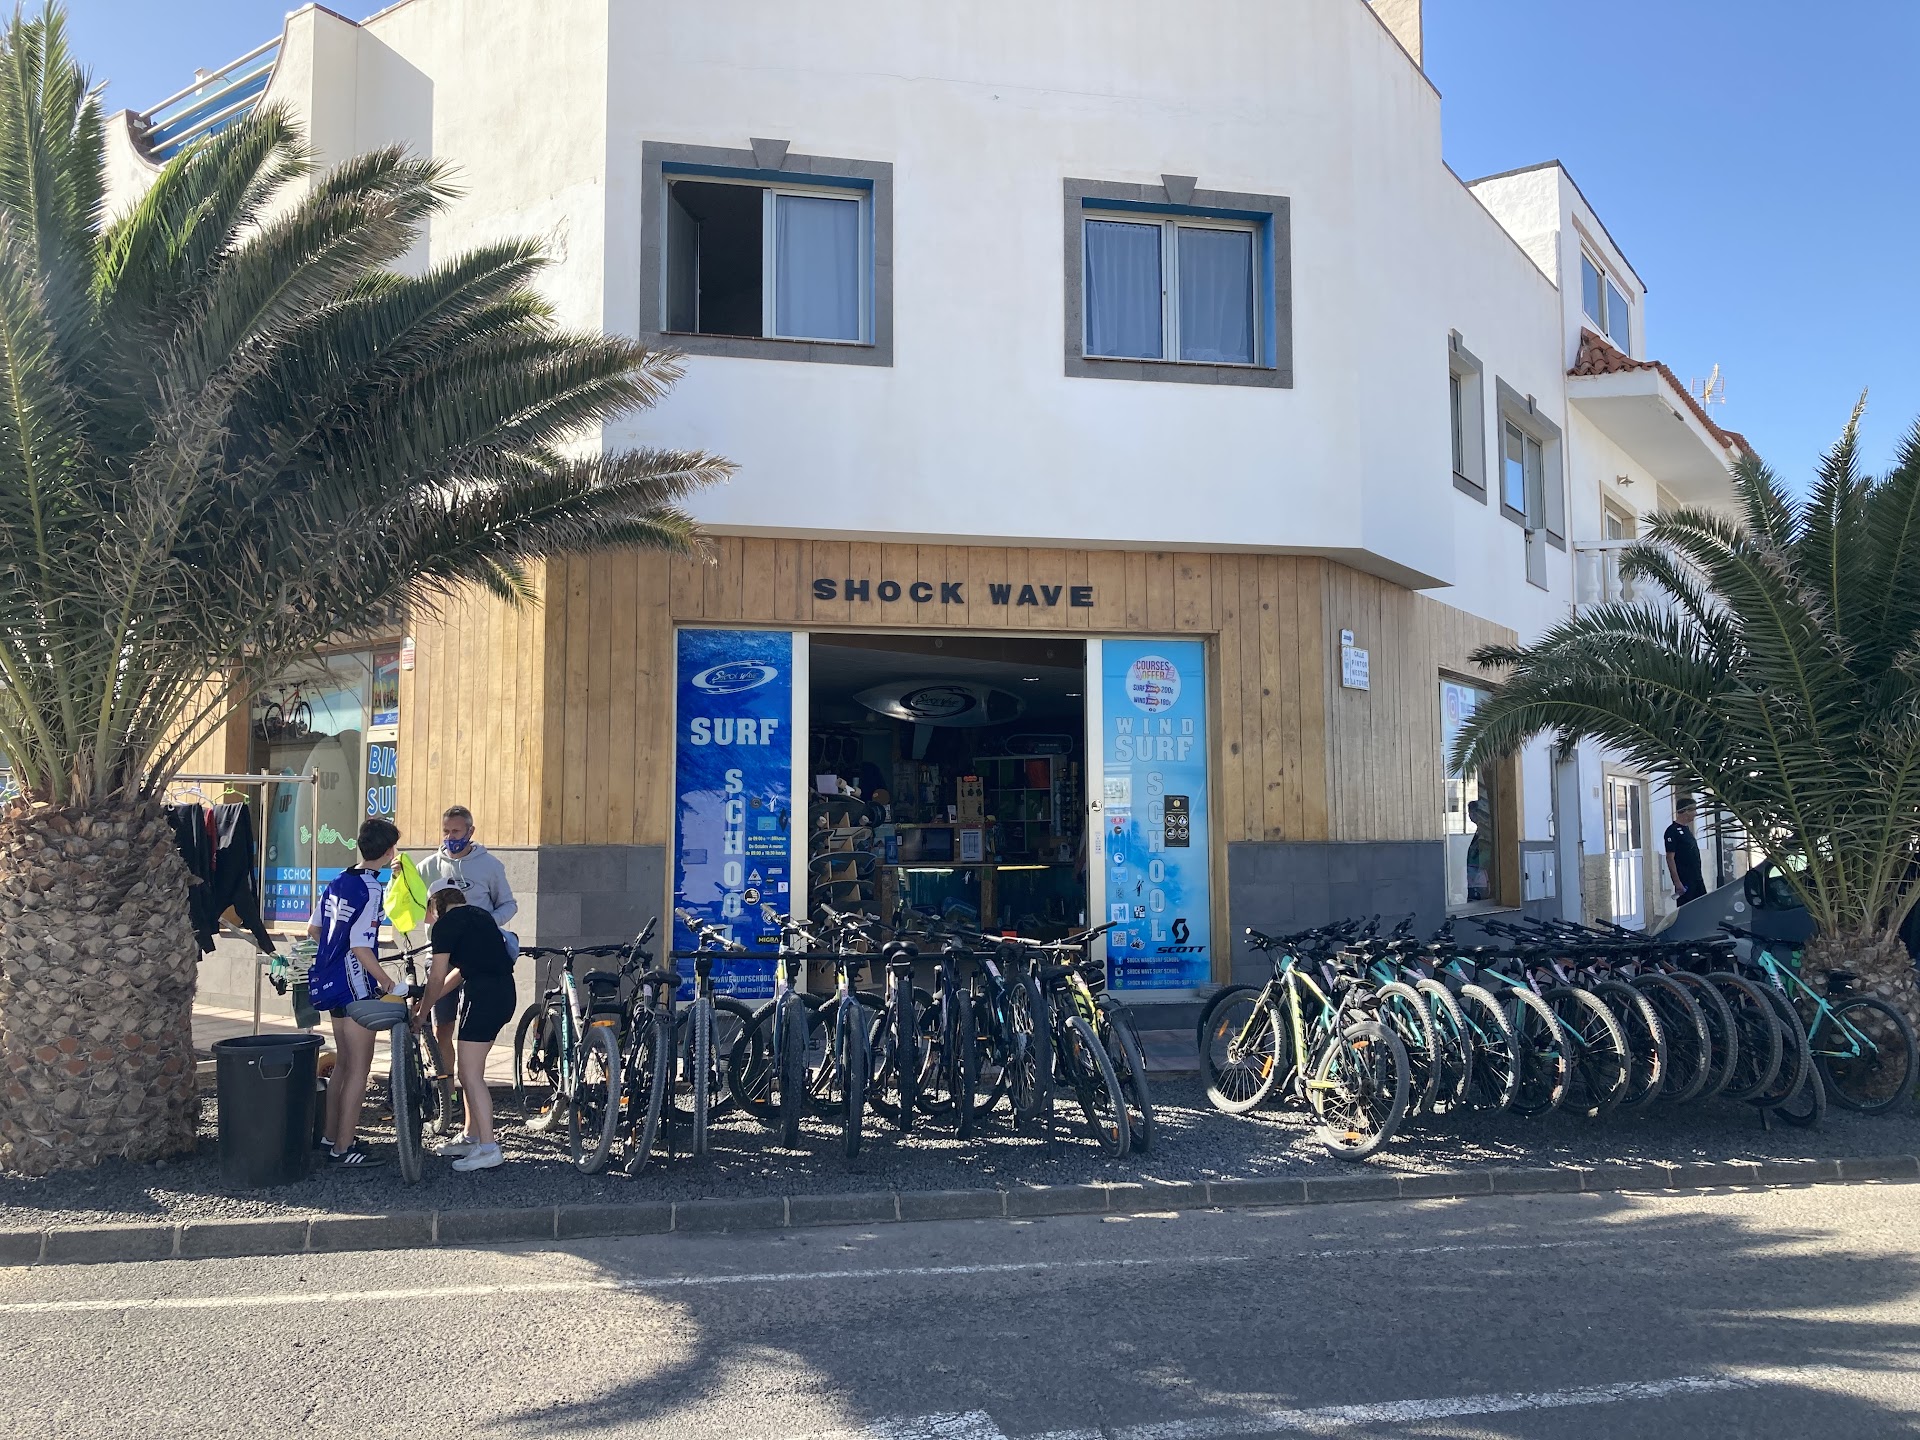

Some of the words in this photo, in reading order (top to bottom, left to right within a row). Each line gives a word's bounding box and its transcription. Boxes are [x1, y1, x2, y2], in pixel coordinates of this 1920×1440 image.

[813, 579, 964, 604] SHOCK
[989, 584, 1093, 607] WAVE
[1136, 660, 1170, 671] COURSES
[1142, 670, 1165, 680] OFFER
[1133, 684, 1145, 692] SURF
[690, 717, 779, 745] SURF
[1115, 717, 1194, 735] WIND
[1115, 735, 1194, 762] SURF
[368, 745, 397, 778] BIK
[320, 771, 340, 790] UP
[279, 794, 293, 813] UP
[367, 785, 397, 816] SU
[723, 769, 744, 946] SCHOOL
[1147, 771, 1167, 942] SCHOOL
[284, 869, 311, 880] SCHOO
[265, 884, 282, 895] URF
[290, 884, 309, 895] WIN
[281, 900, 305, 909] SHOP
[1156, 946, 1206, 954] SCOTT
